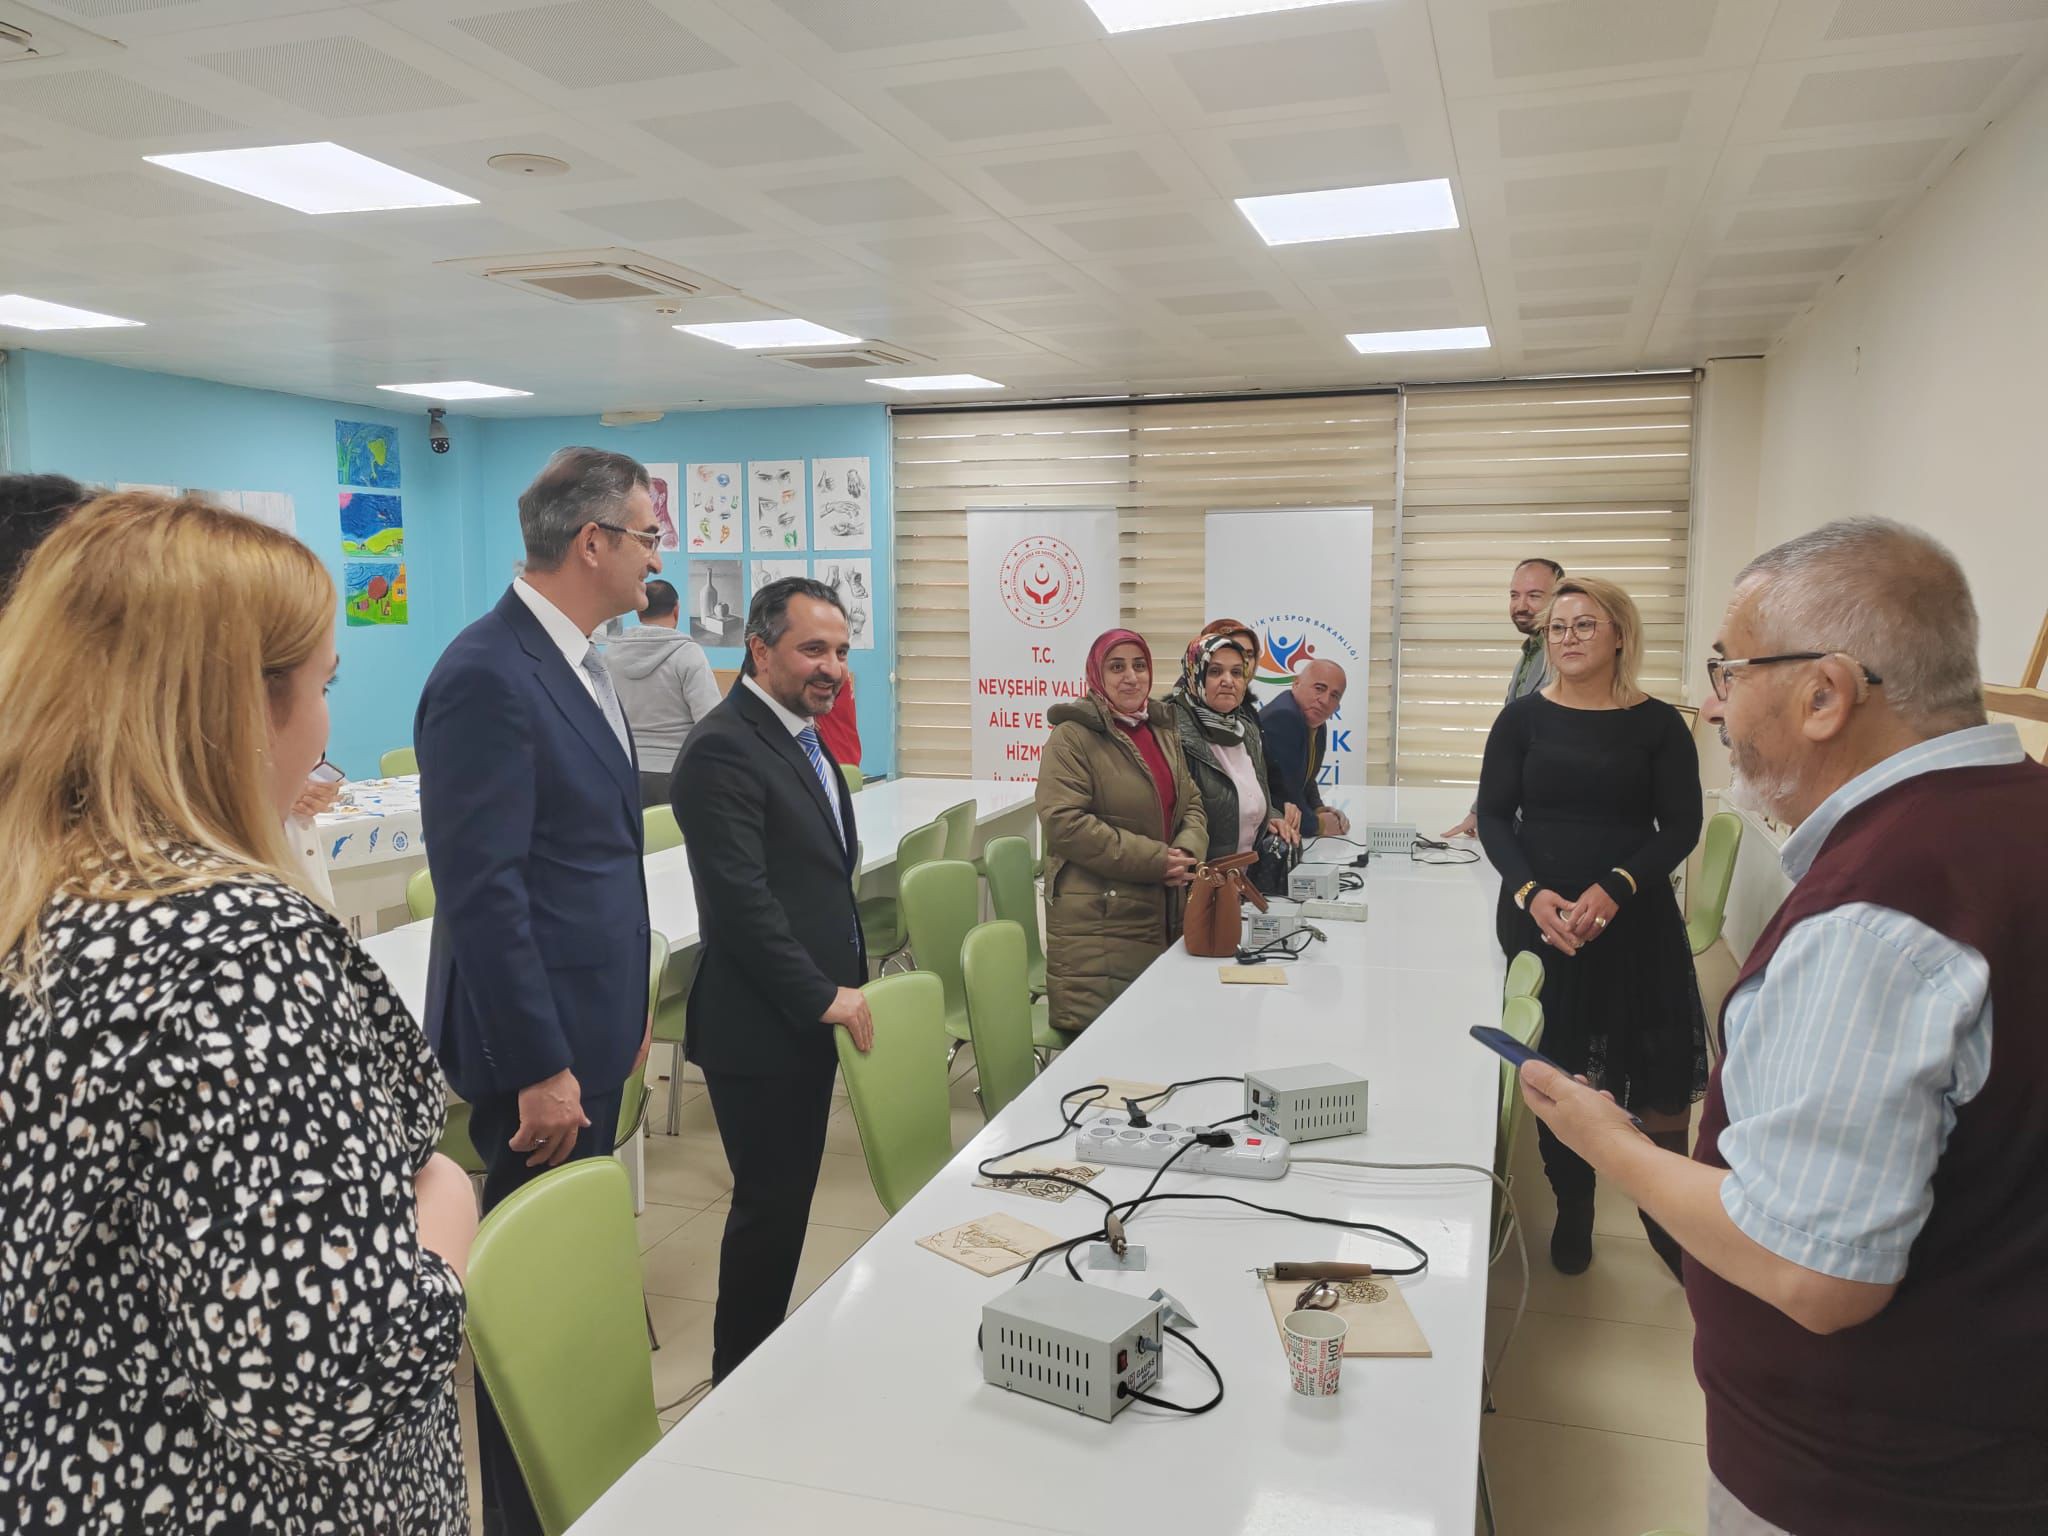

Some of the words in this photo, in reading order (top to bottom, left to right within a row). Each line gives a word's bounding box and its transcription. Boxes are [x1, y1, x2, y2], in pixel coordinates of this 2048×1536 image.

[1285, 614, 1311, 624] SPOR
[1032, 646, 1055, 664] T.C.
[978, 676, 1048, 698] NEVŞEHİR
[989, 707, 1020, 728] AİLE
[1024, 712, 1043, 729] VE
[1327, 1338, 1339, 1362] HOT
